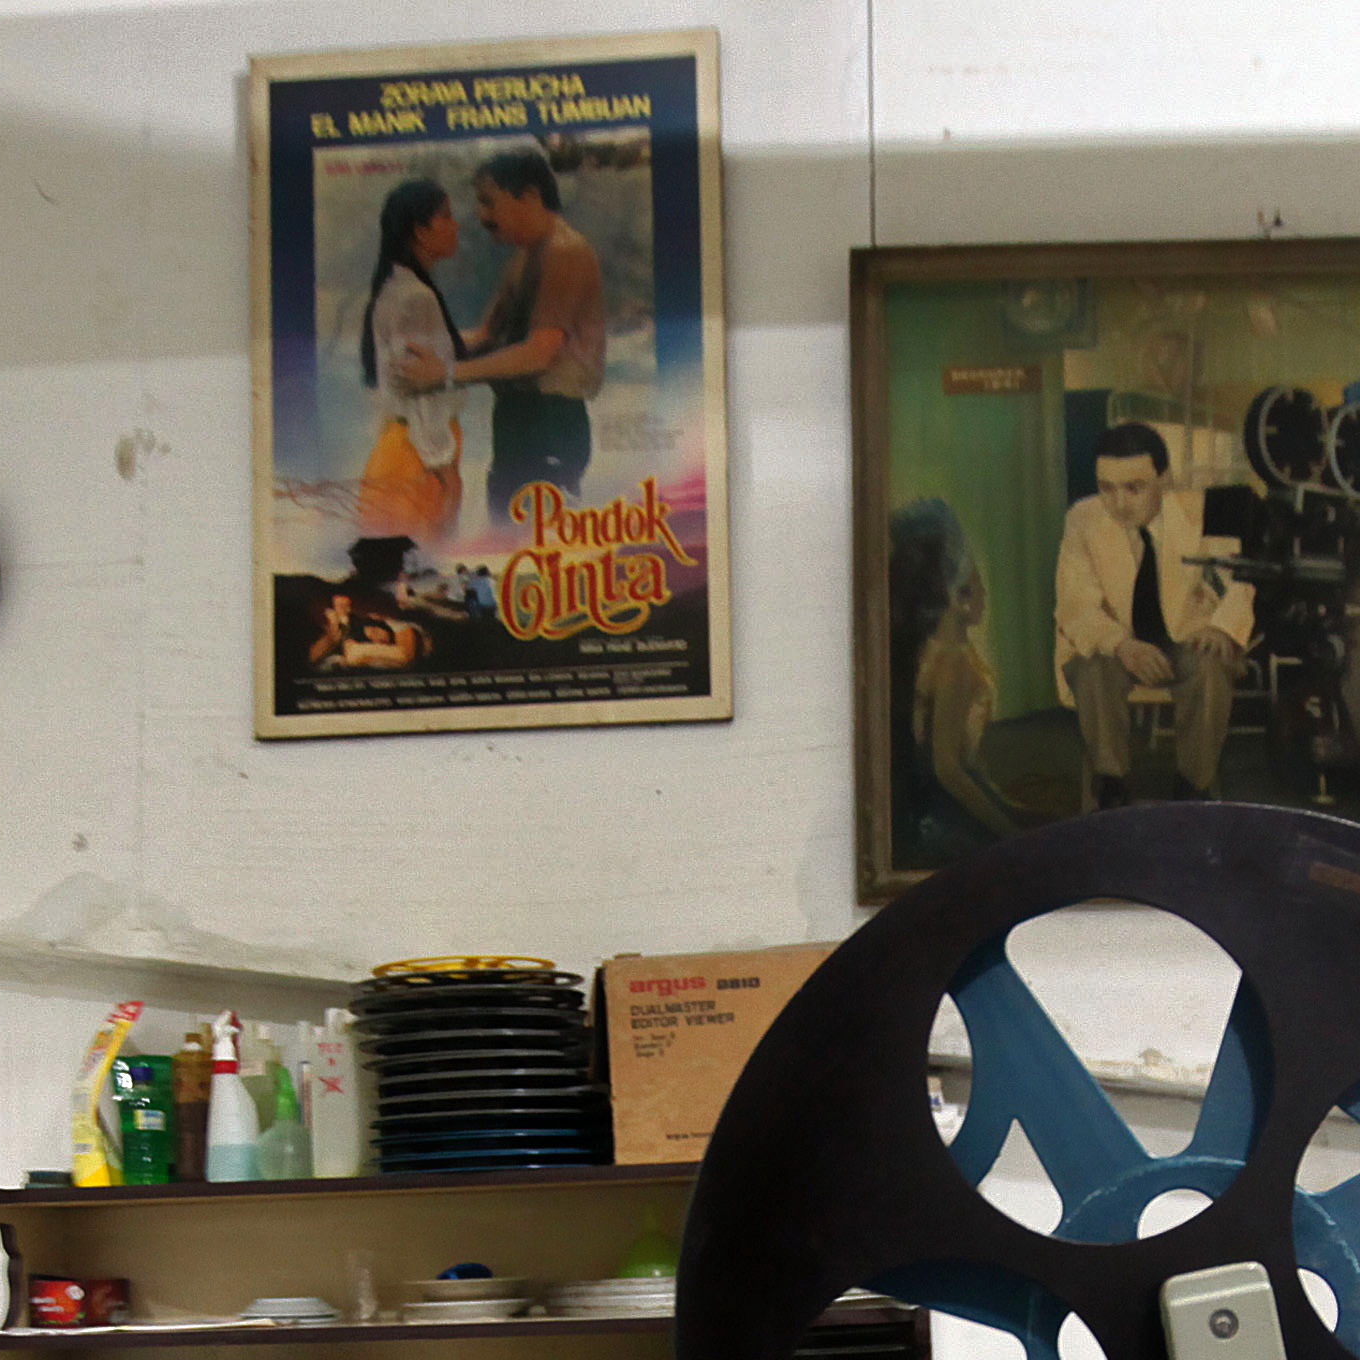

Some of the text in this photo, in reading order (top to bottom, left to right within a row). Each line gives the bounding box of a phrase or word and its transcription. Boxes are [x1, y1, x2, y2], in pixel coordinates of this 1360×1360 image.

[311, 112, 340, 138] EL
[446, 102, 528, 130] FRANS
[509, 475, 698, 566] Pondok
[629, 976, 706, 997] argus
[631, 1012, 736, 1030] EDITOR VIEWER
